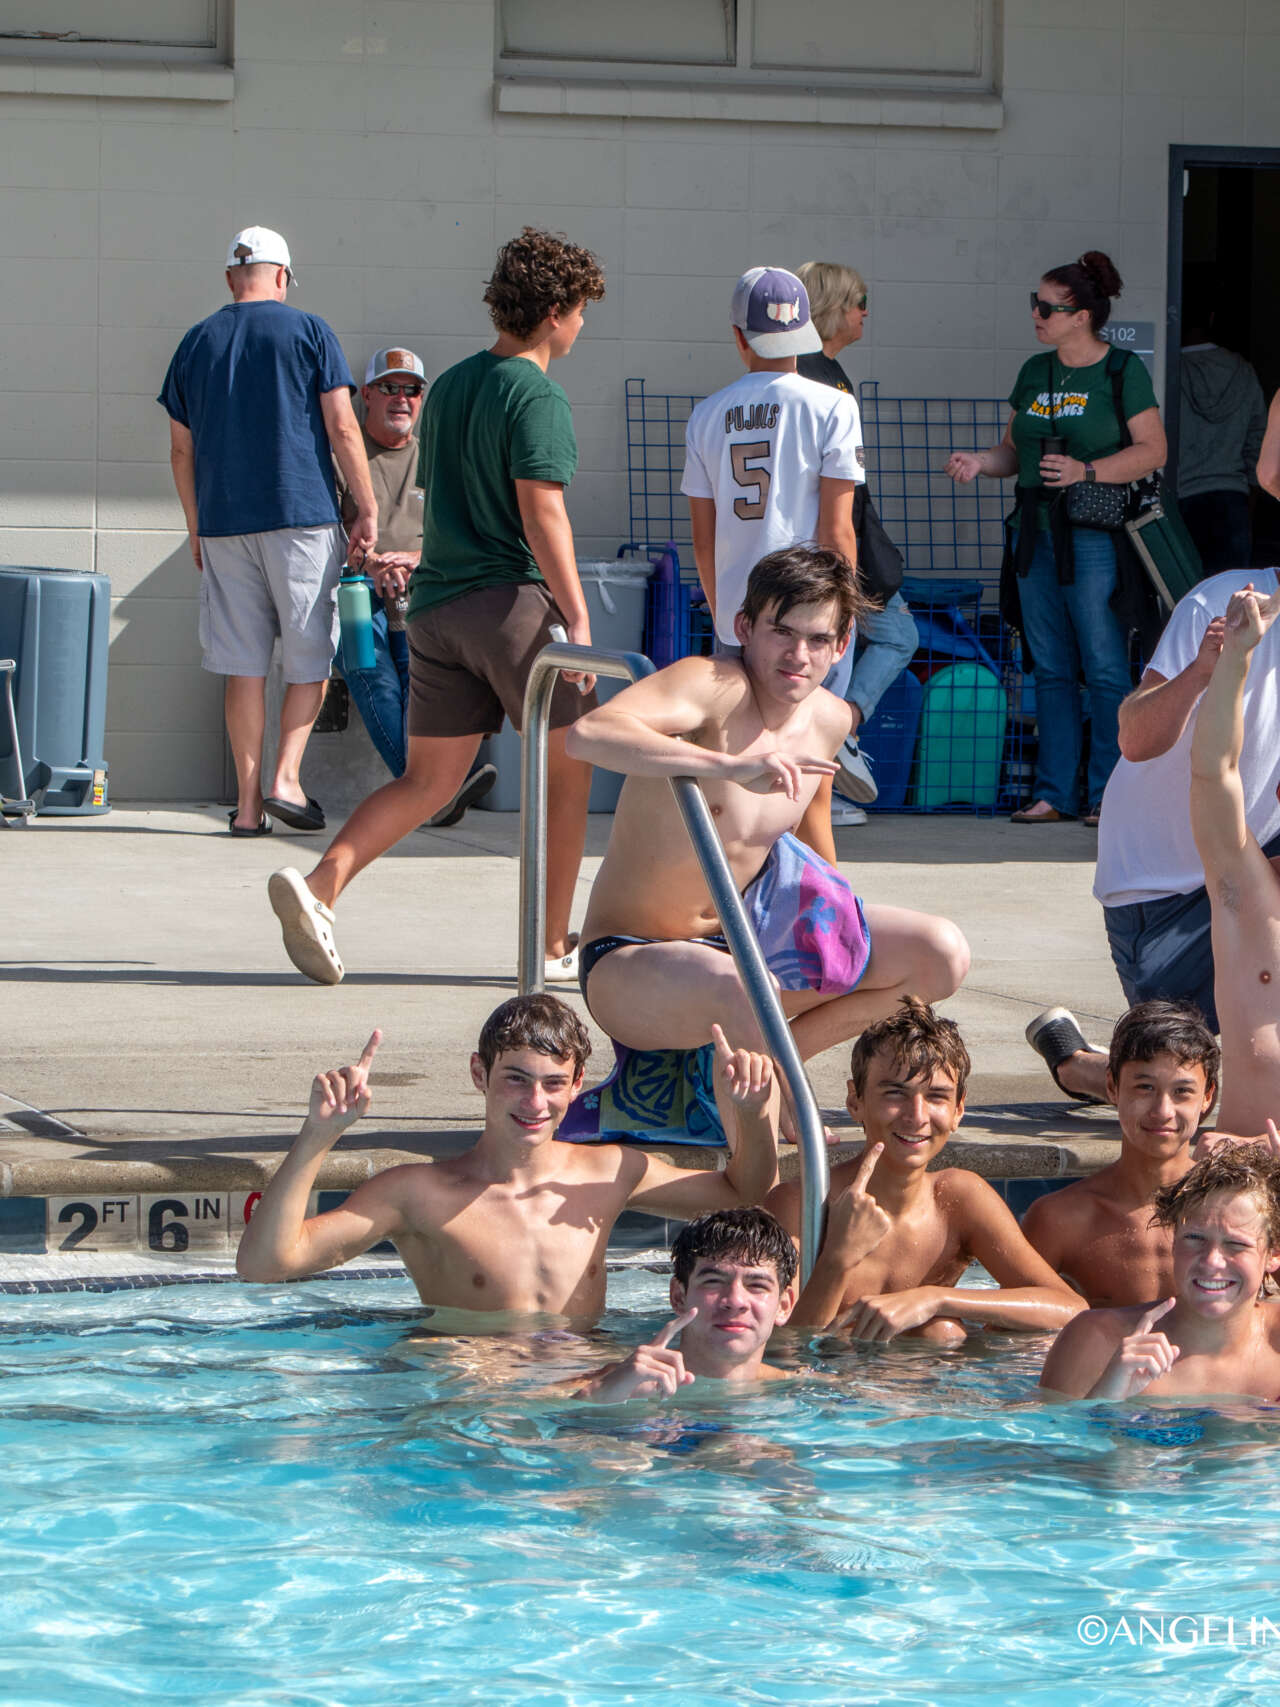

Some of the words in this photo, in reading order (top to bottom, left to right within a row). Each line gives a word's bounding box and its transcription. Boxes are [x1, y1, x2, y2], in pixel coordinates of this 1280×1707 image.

[730, 440, 771, 520] 5
[58, 1202, 98, 1252] 2
[102, 1201, 130, 1223] FT
[149, 1199, 189, 1252] 6
[195, 1198, 220, 1219] IN
